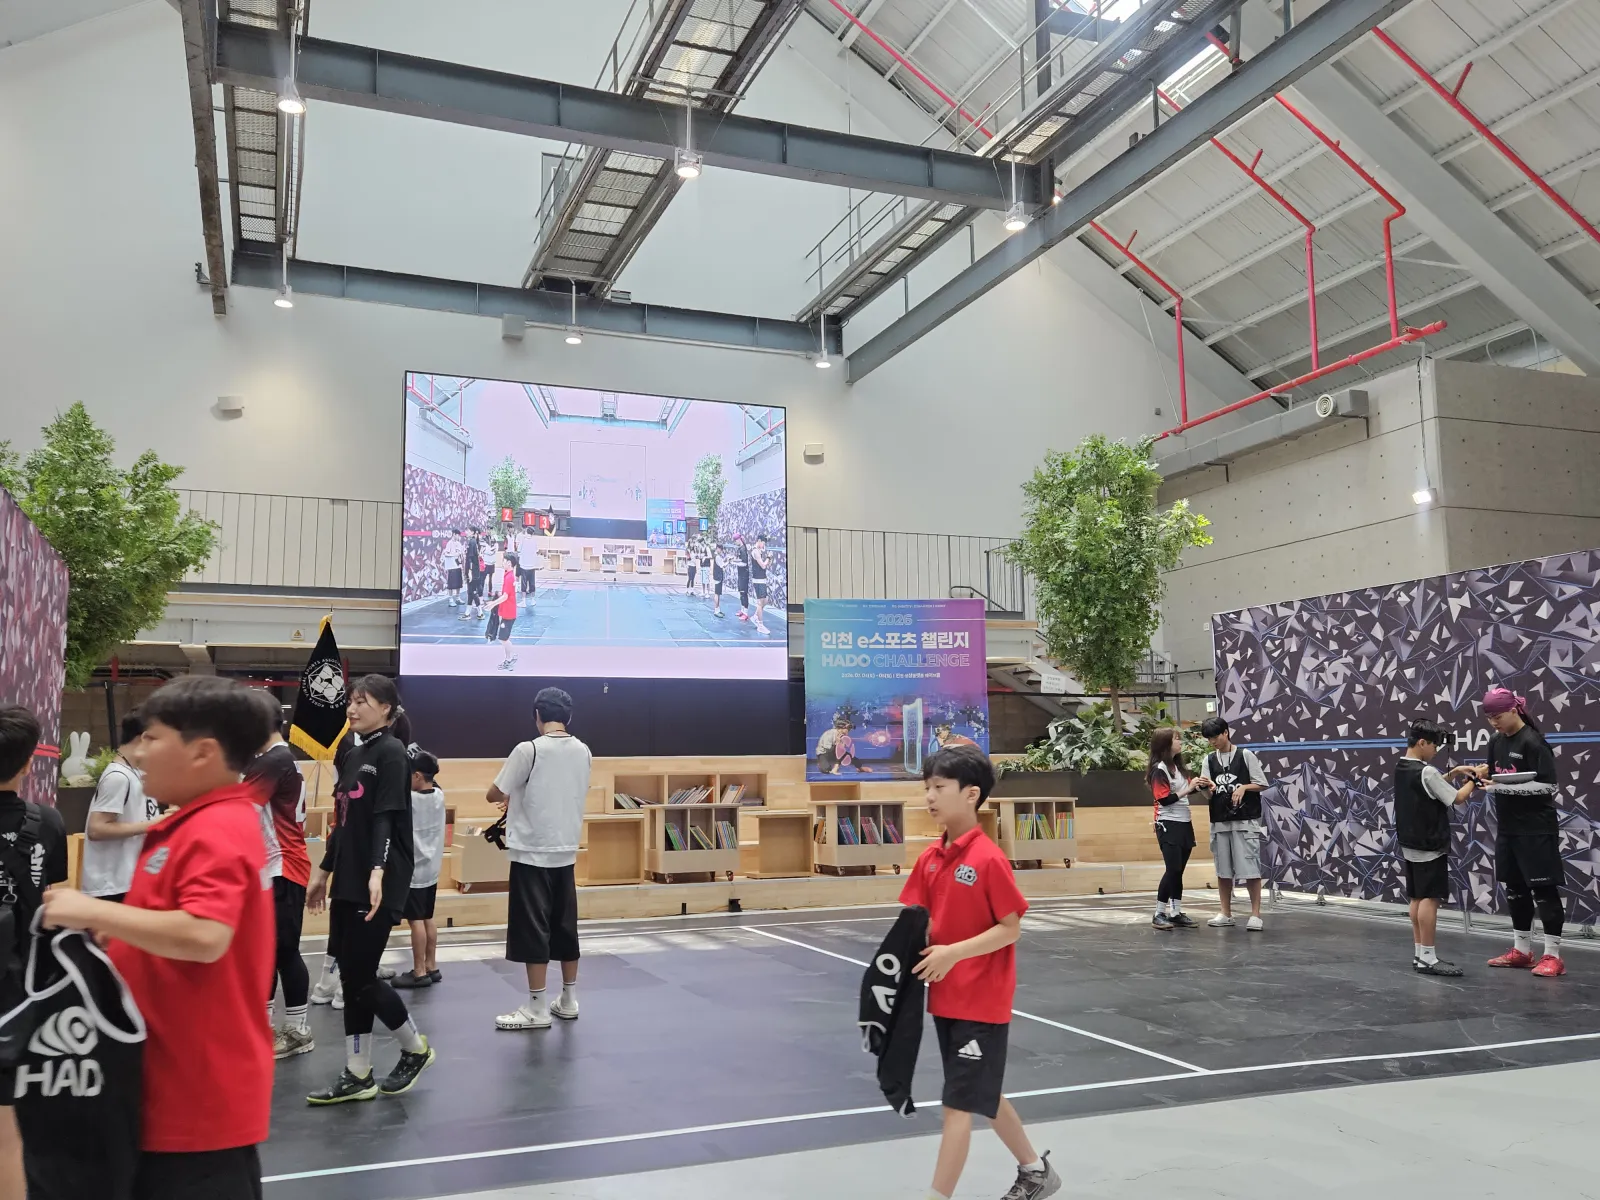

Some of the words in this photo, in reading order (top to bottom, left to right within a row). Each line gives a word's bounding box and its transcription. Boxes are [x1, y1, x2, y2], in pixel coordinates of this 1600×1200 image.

[504, 509, 510, 521] 2
[527, 513, 532, 525] 1
[542, 518, 547, 528] 3
[876, 613, 913, 626] 2026
[820, 631, 853, 649] 인천
[857, 632, 917, 649] e스포츠
[921, 631, 969, 649] 챌린지
[821, 654, 871, 668] HADO
[873, 653, 970, 667] CHALLENGE
[1453, 728, 1491, 752] HA
[13, 1058, 105, 1099] HAD
